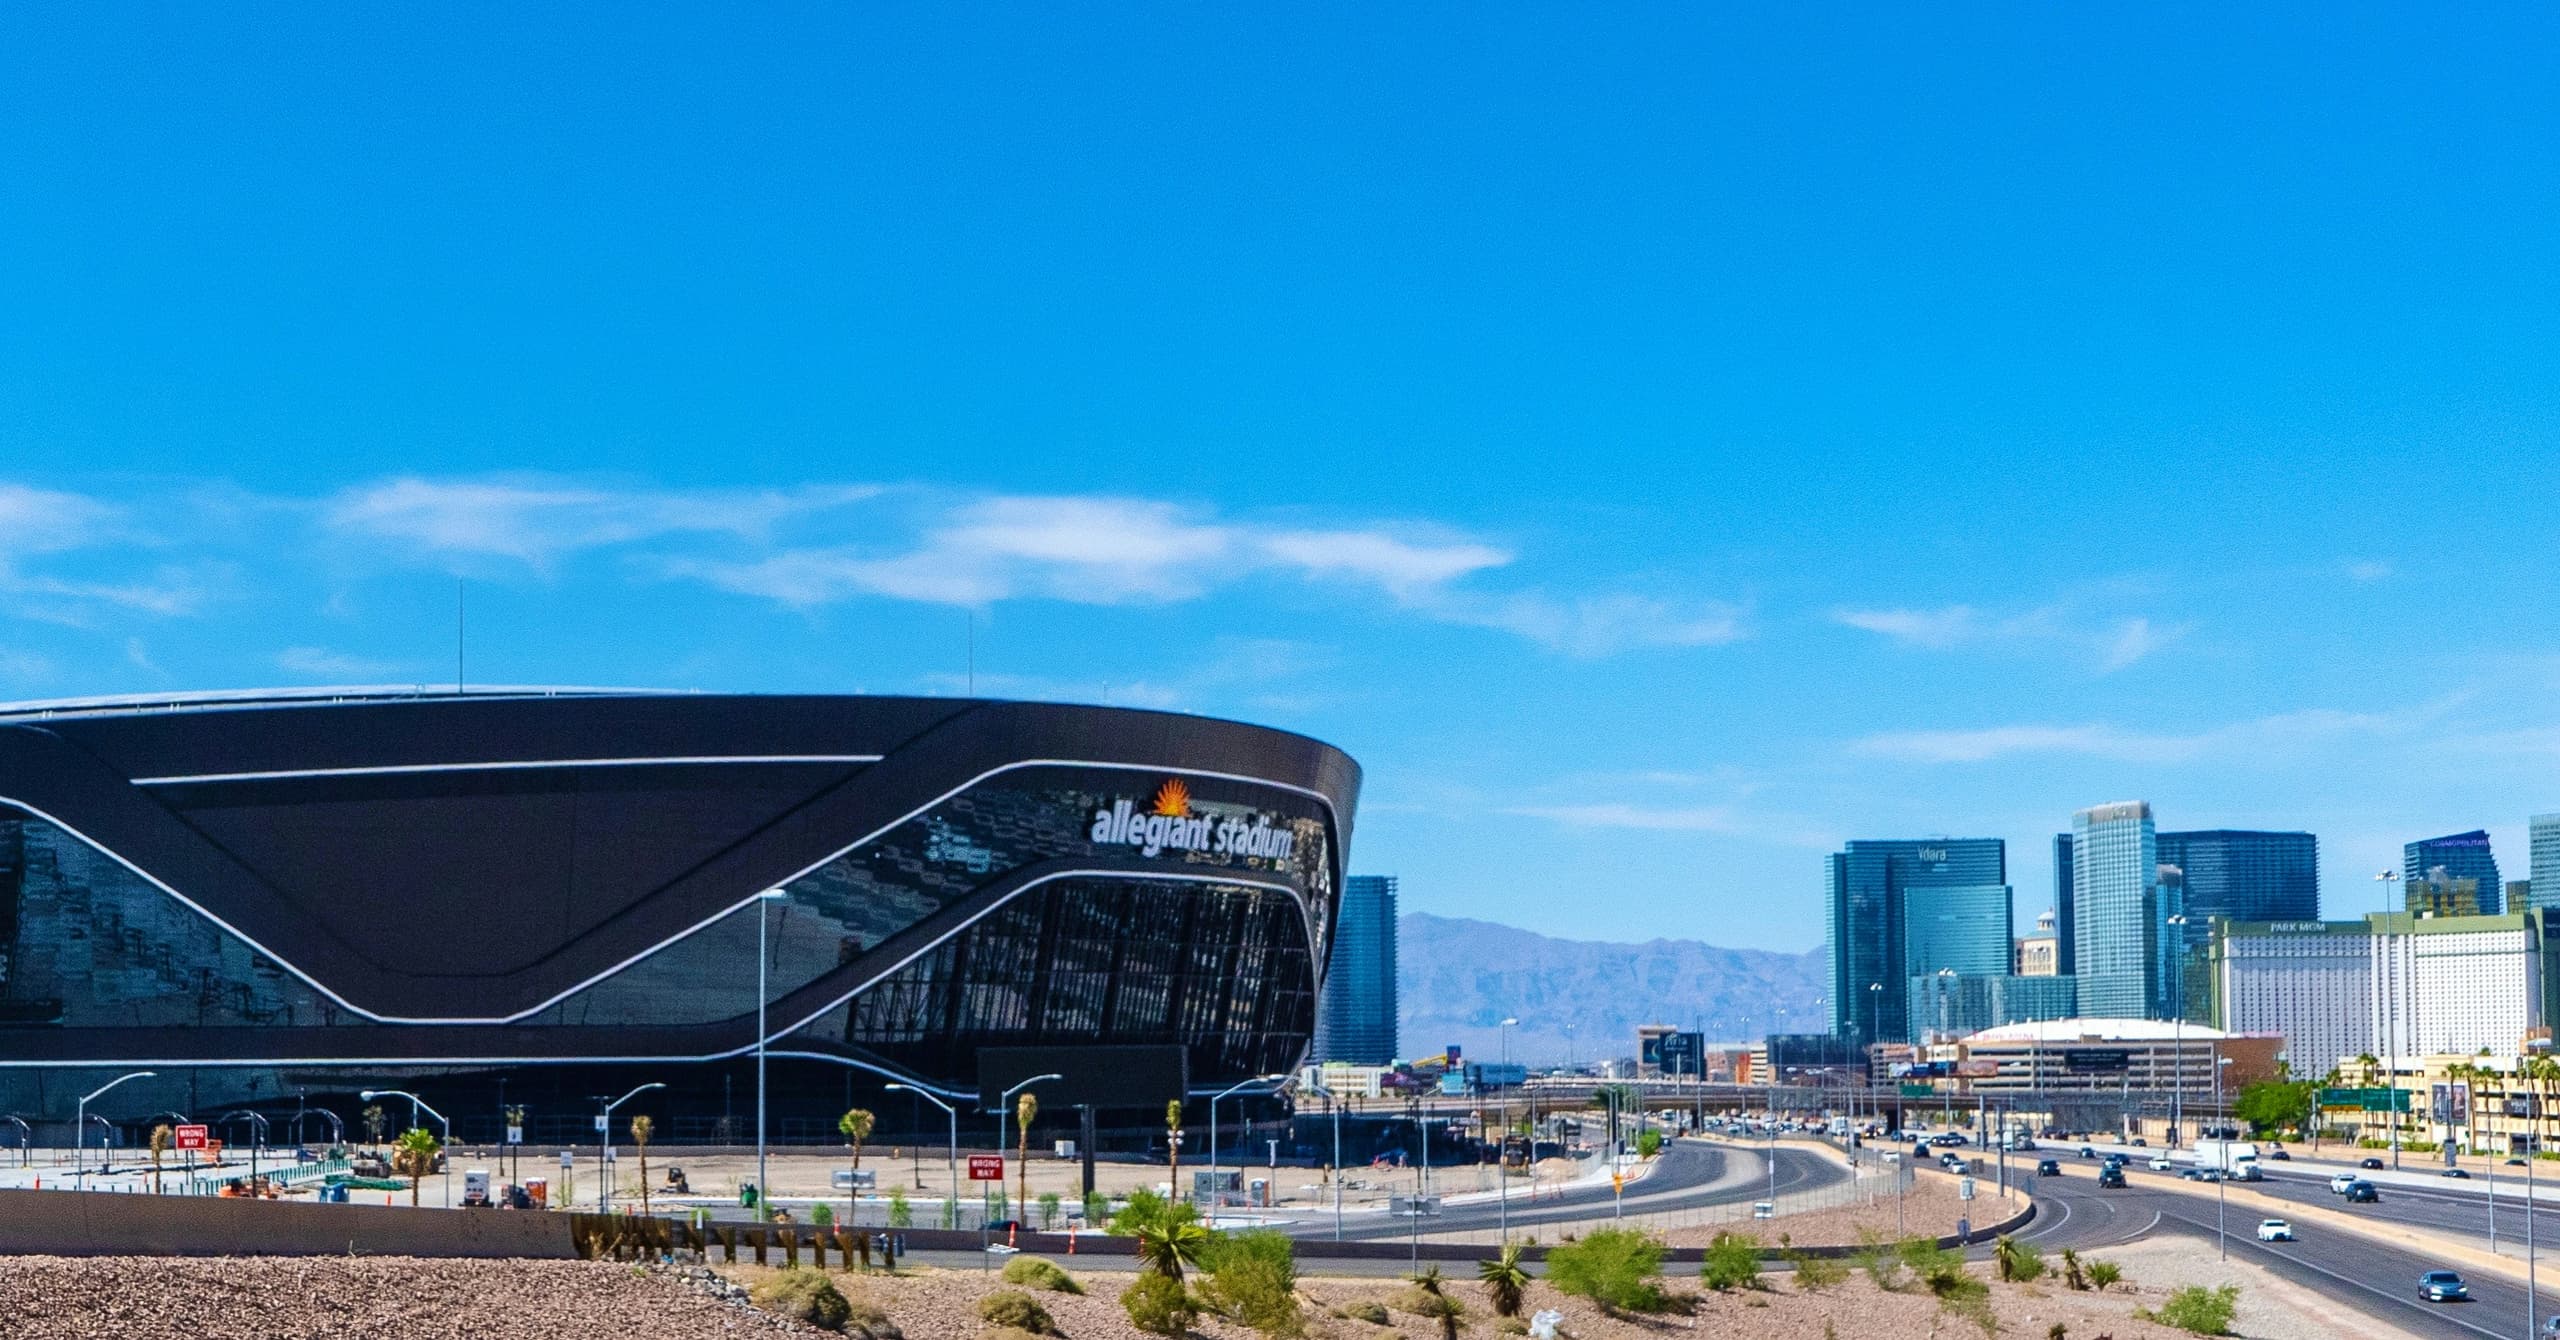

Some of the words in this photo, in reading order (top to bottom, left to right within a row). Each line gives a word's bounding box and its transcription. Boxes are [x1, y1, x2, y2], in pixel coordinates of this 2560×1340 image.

[1091, 799, 1212, 857] allegiant
[1216, 815, 1294, 859] stadium
[1918, 846, 1946, 861] Vdara
[2271, 922, 2297, 932] PARK
[2299, 922, 2326, 932] MGM
[179, 1129, 205, 1137] WRONG
[184, 1138, 200, 1146] WAY
[971, 1159, 1001, 1168] WRONG
[976, 1169, 995, 1178] WAY
